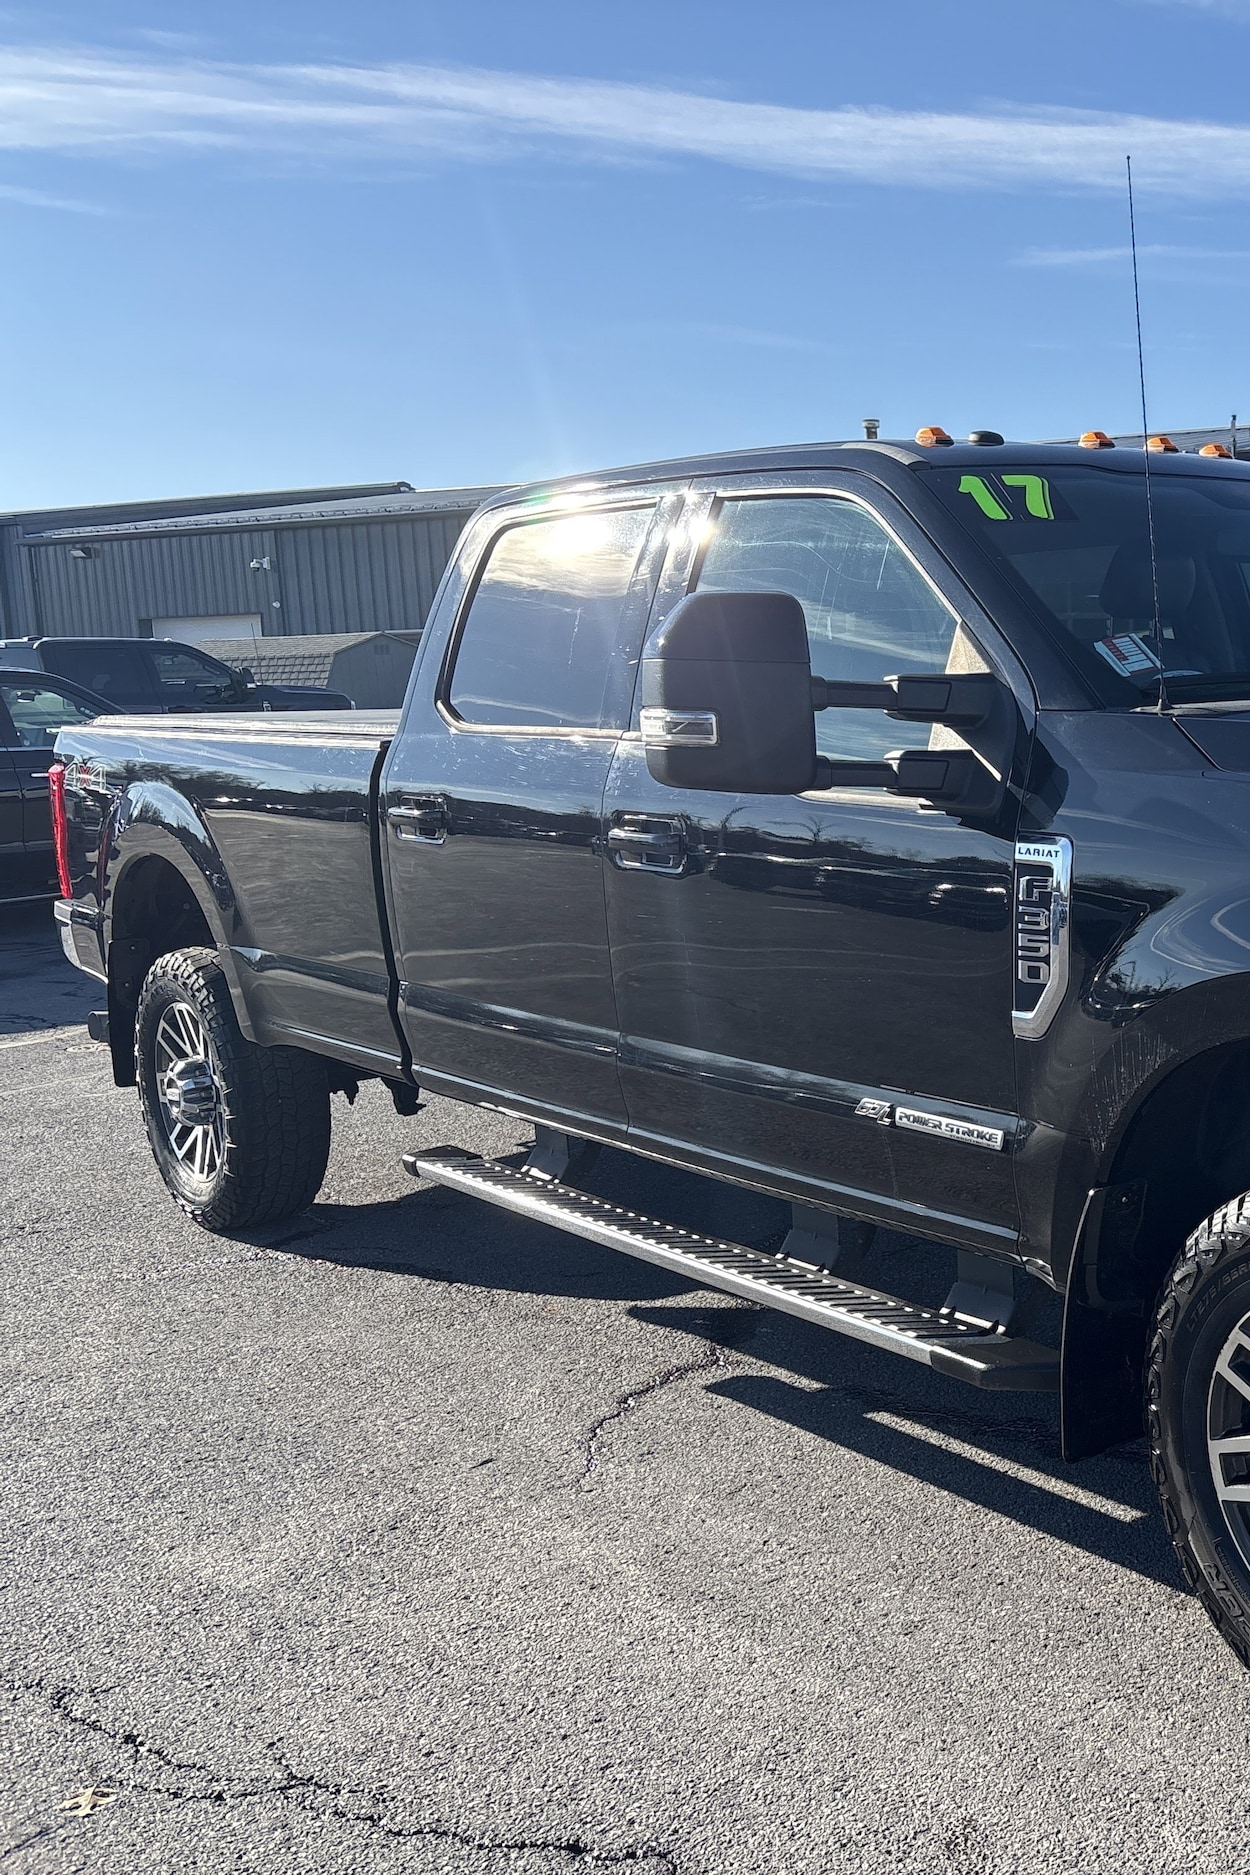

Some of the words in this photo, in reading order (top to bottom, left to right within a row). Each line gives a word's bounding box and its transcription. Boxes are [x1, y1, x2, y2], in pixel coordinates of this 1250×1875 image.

[958, 475, 1054, 520] 17
[1018, 846, 1060, 858] LARIAT
[899, 1111, 943, 1131] POWER
[944, 1123, 999, 1145] STROKE
